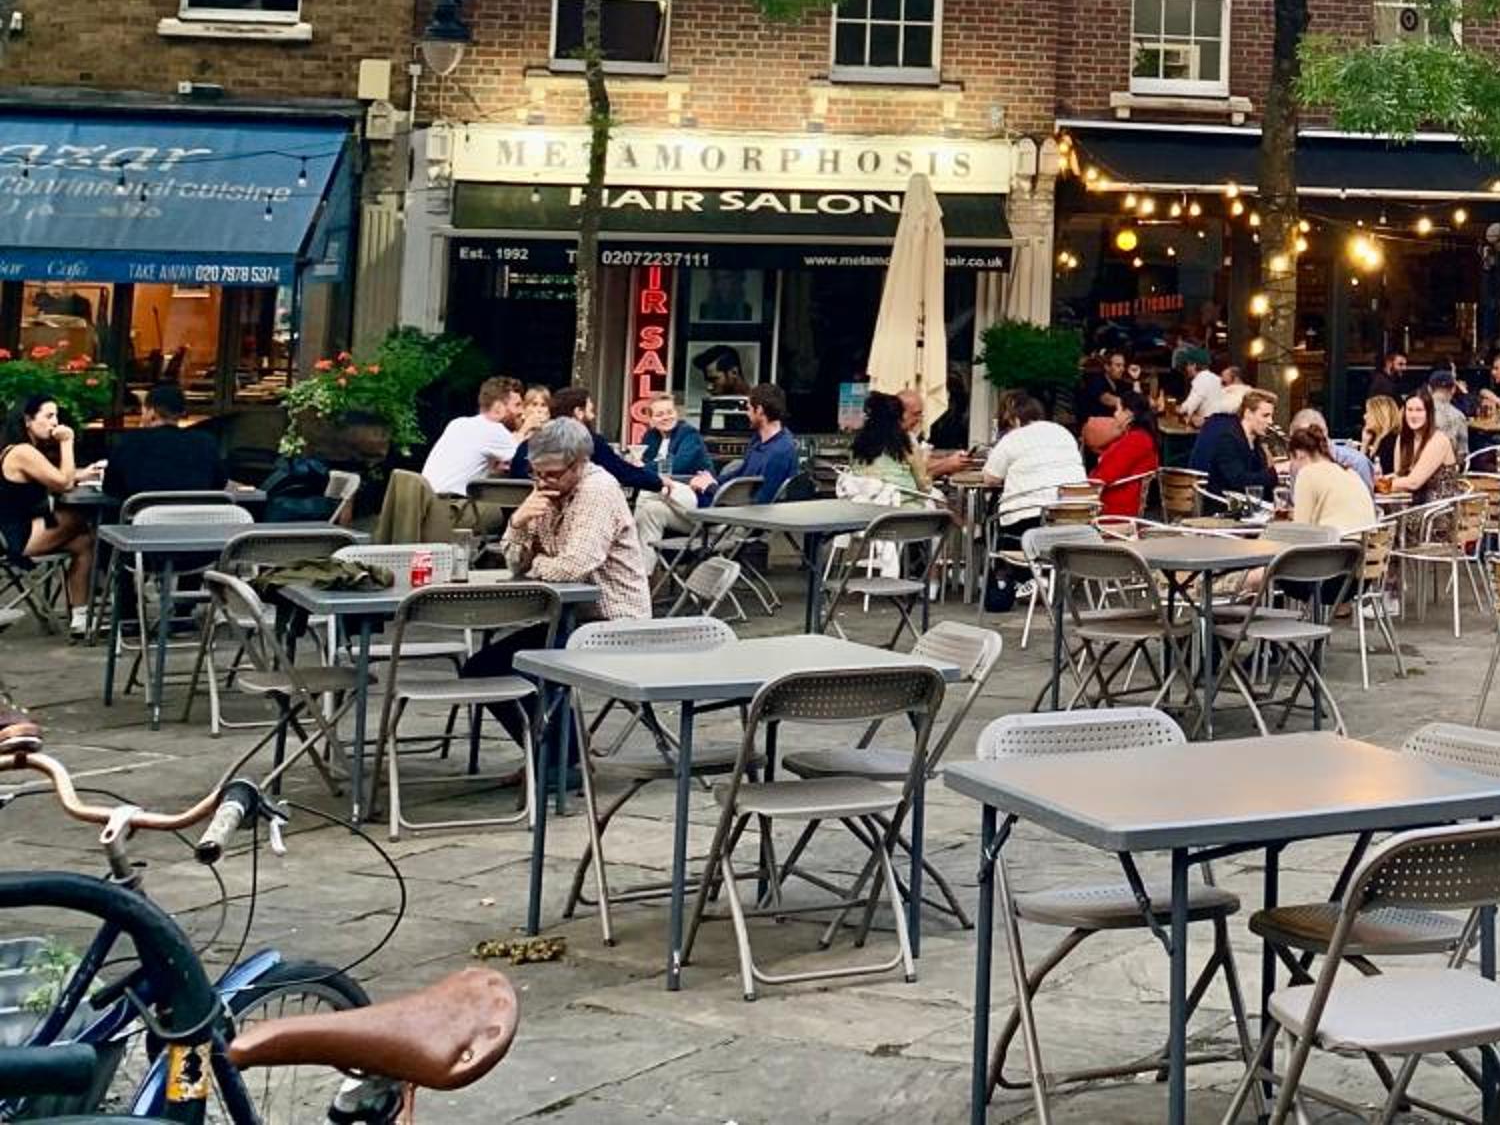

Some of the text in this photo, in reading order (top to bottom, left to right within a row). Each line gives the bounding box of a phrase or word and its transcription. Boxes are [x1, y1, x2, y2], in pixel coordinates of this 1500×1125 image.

[178, 183, 291, 203] cuisine
[719, 190, 902, 213] SALON
[496, 248, 529, 260] 1992
[602, 250, 709, 266] 02072237111
[129, 264, 156, 279] TAKE
[159, 264, 193, 280] AWAY
[195, 264, 219, 282] 020
[220, 266, 249, 282] 7978
